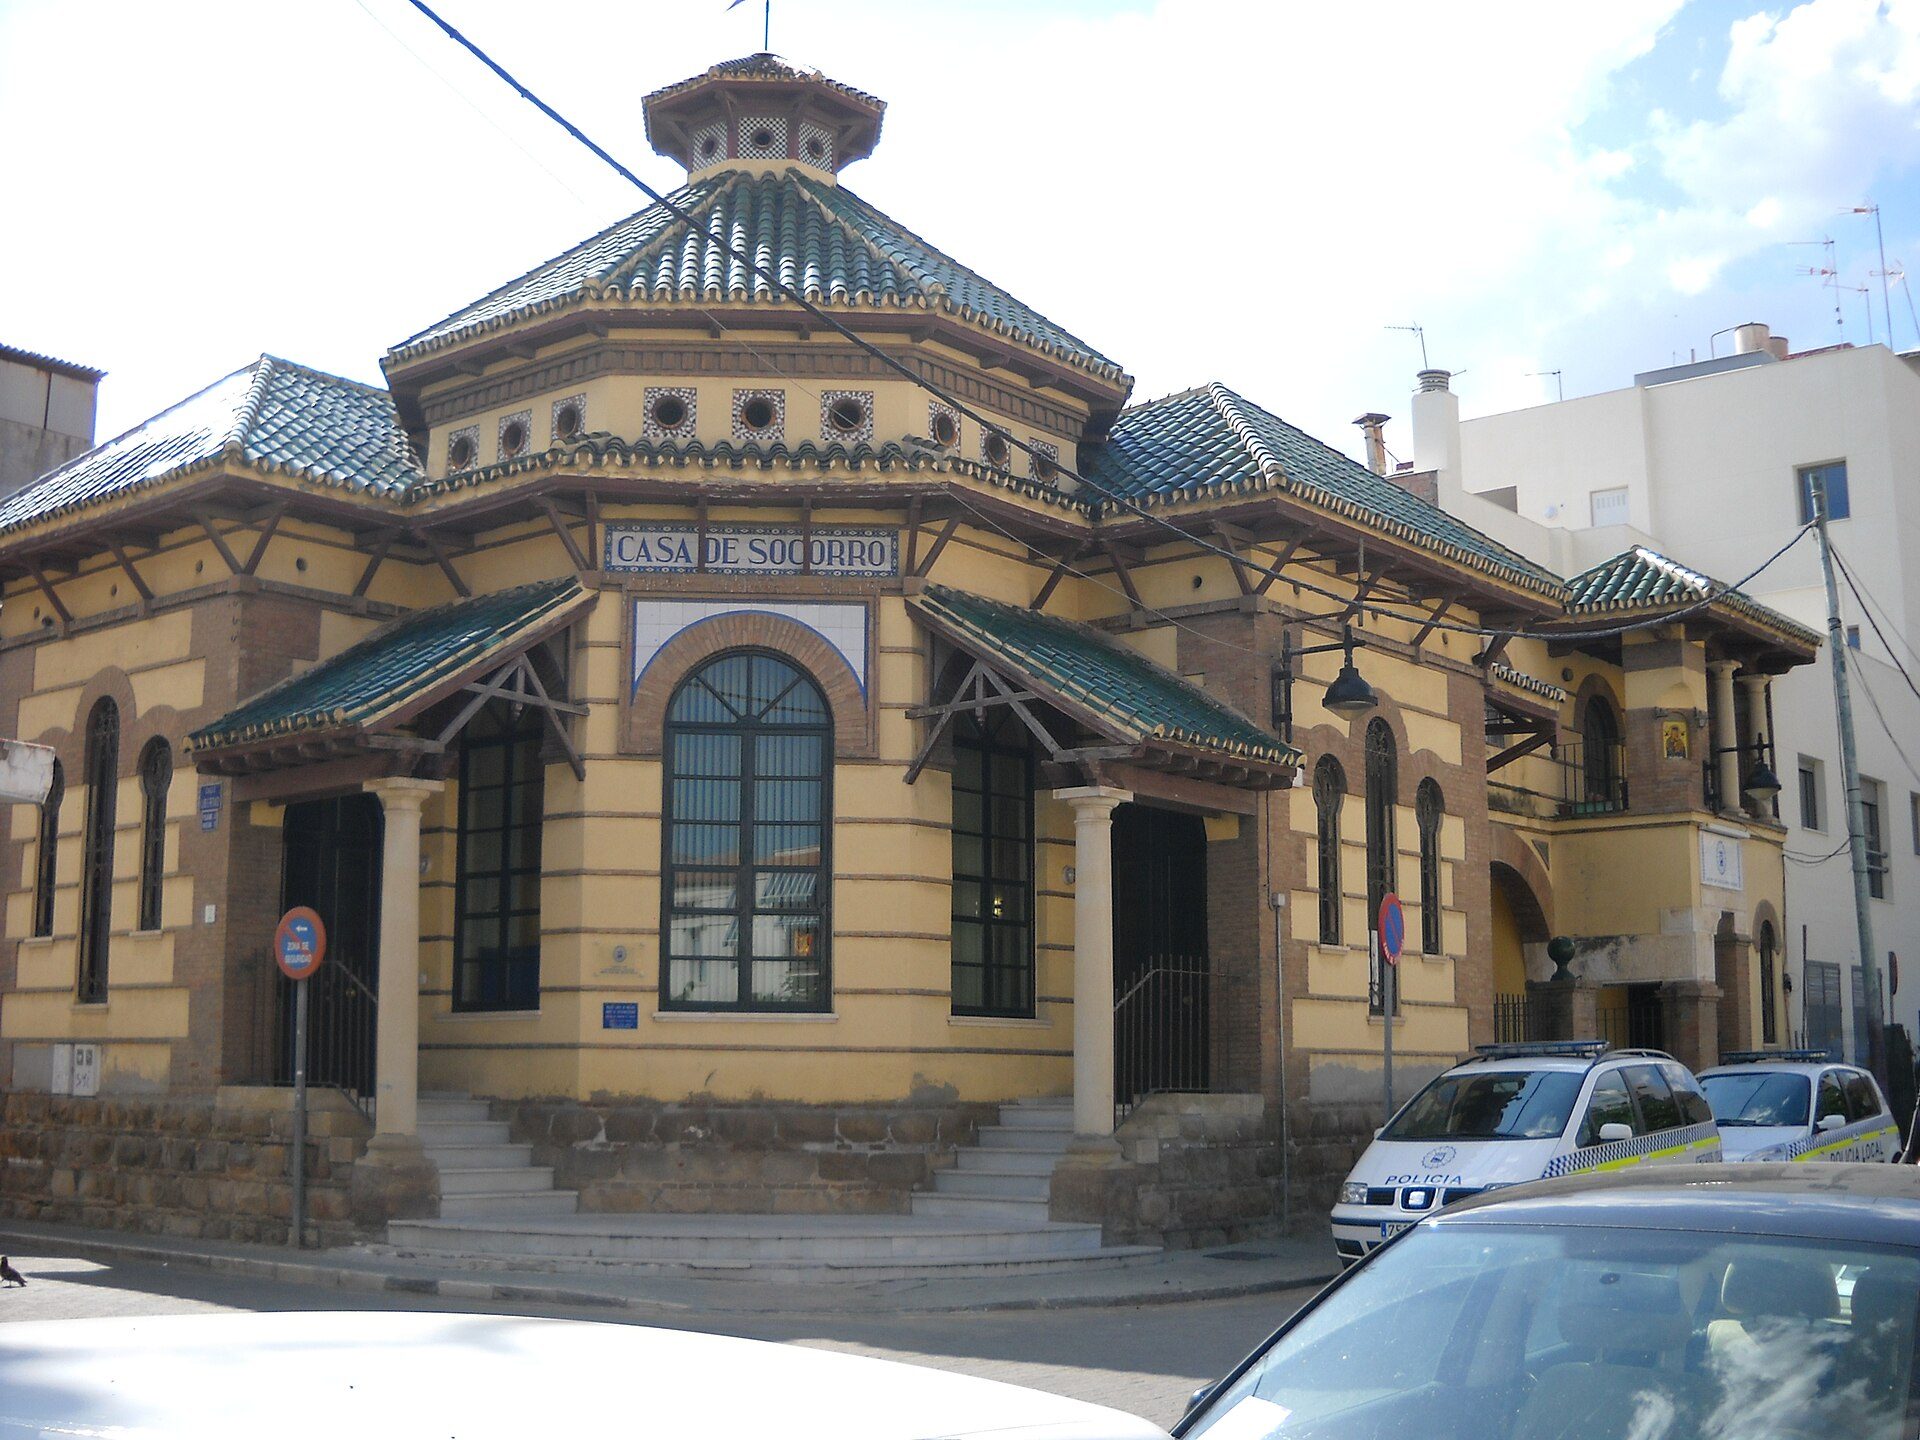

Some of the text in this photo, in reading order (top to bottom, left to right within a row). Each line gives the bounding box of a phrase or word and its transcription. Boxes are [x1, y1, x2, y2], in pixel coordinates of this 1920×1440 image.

[617, 535, 886, 567] CASA DE SOCORRO
[1385, 1174, 1463, 1185] POLICIA
